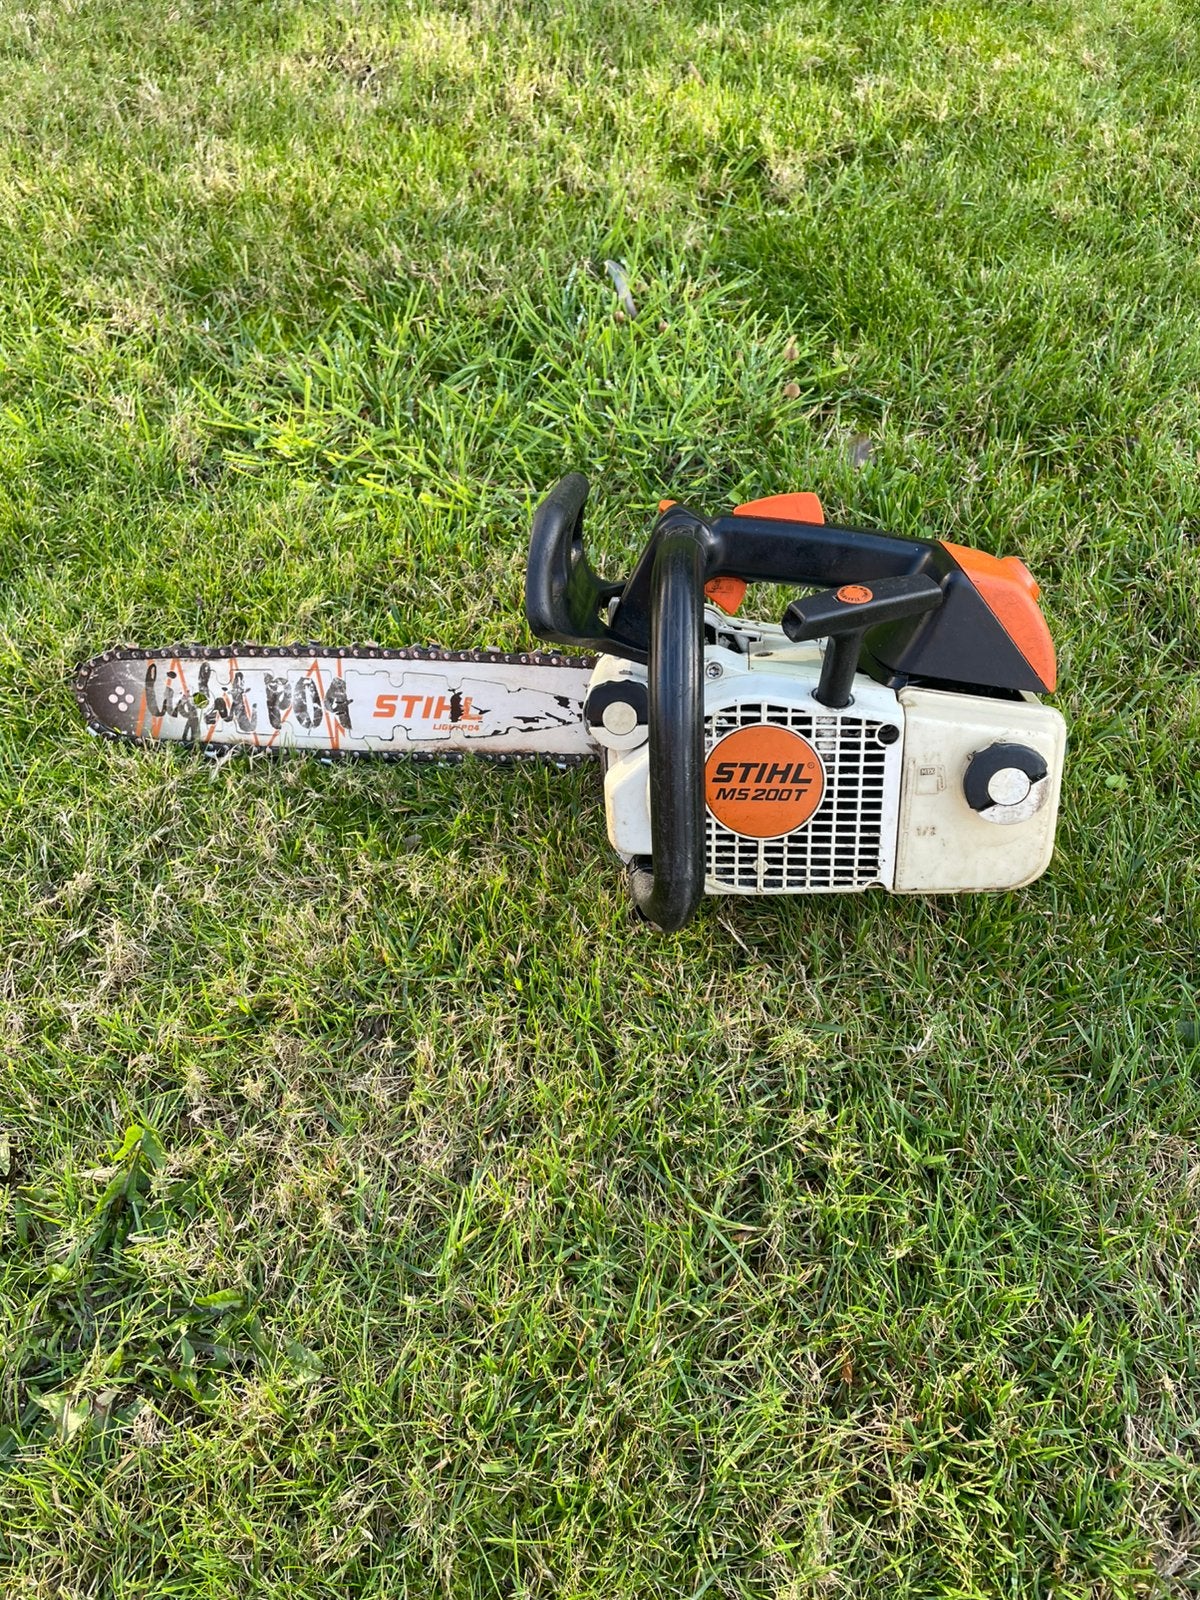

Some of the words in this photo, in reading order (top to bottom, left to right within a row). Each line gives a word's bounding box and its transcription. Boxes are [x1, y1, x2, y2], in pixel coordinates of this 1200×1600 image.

[712, 762, 813, 784] STIHL
[716, 788, 751, 801] MS
[751, 788, 808, 802] 200T
